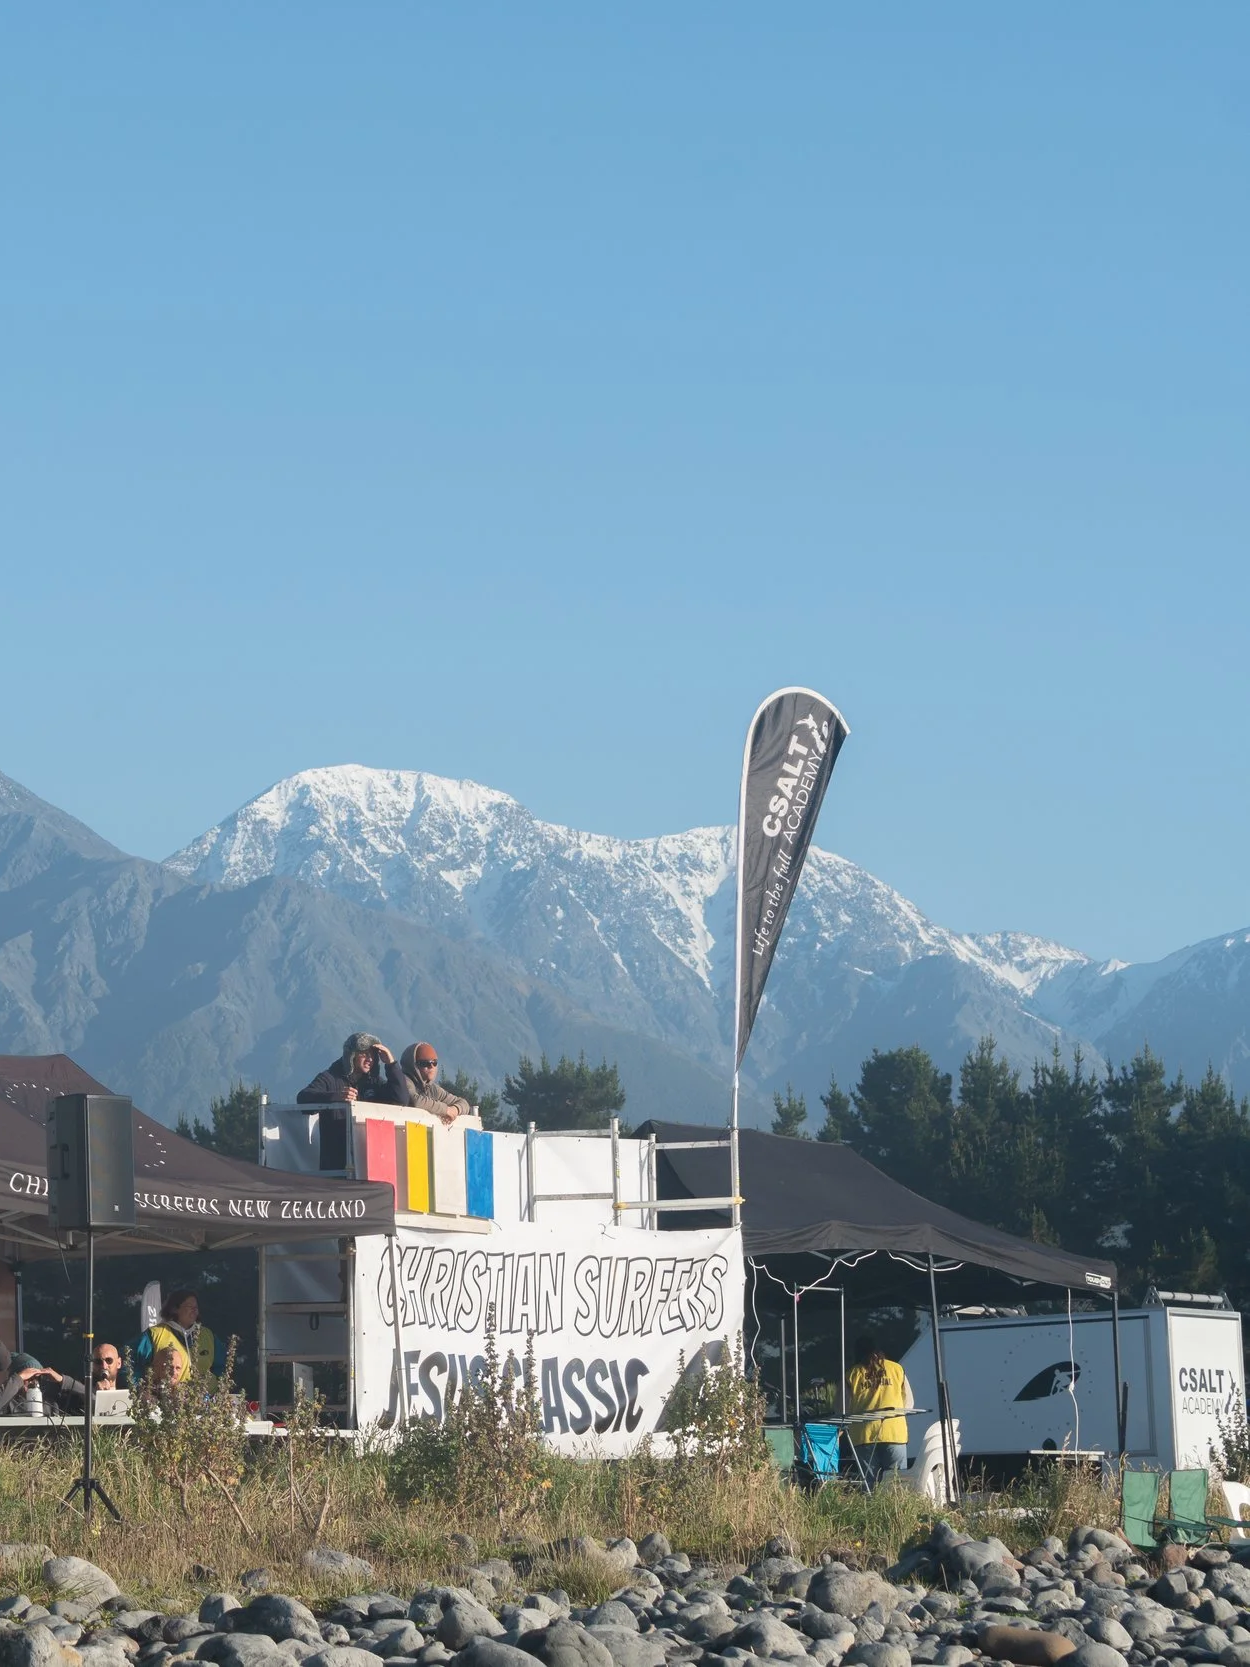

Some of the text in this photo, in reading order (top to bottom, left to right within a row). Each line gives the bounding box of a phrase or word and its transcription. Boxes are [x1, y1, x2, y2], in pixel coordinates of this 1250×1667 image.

[763, 734, 808, 837] CSALT
[783, 749, 823, 844] ACADEMY
[753, 849, 792, 956] Life to the full
[134, 1192, 366, 1219] SURFERS NEW ZEALAND
[377, 1244, 728, 1338] CHRISTIAN SURFERS
[1179, 1367, 1224, 1393] CSALT
[1182, 1397, 1225, 1415] ACADEMY
